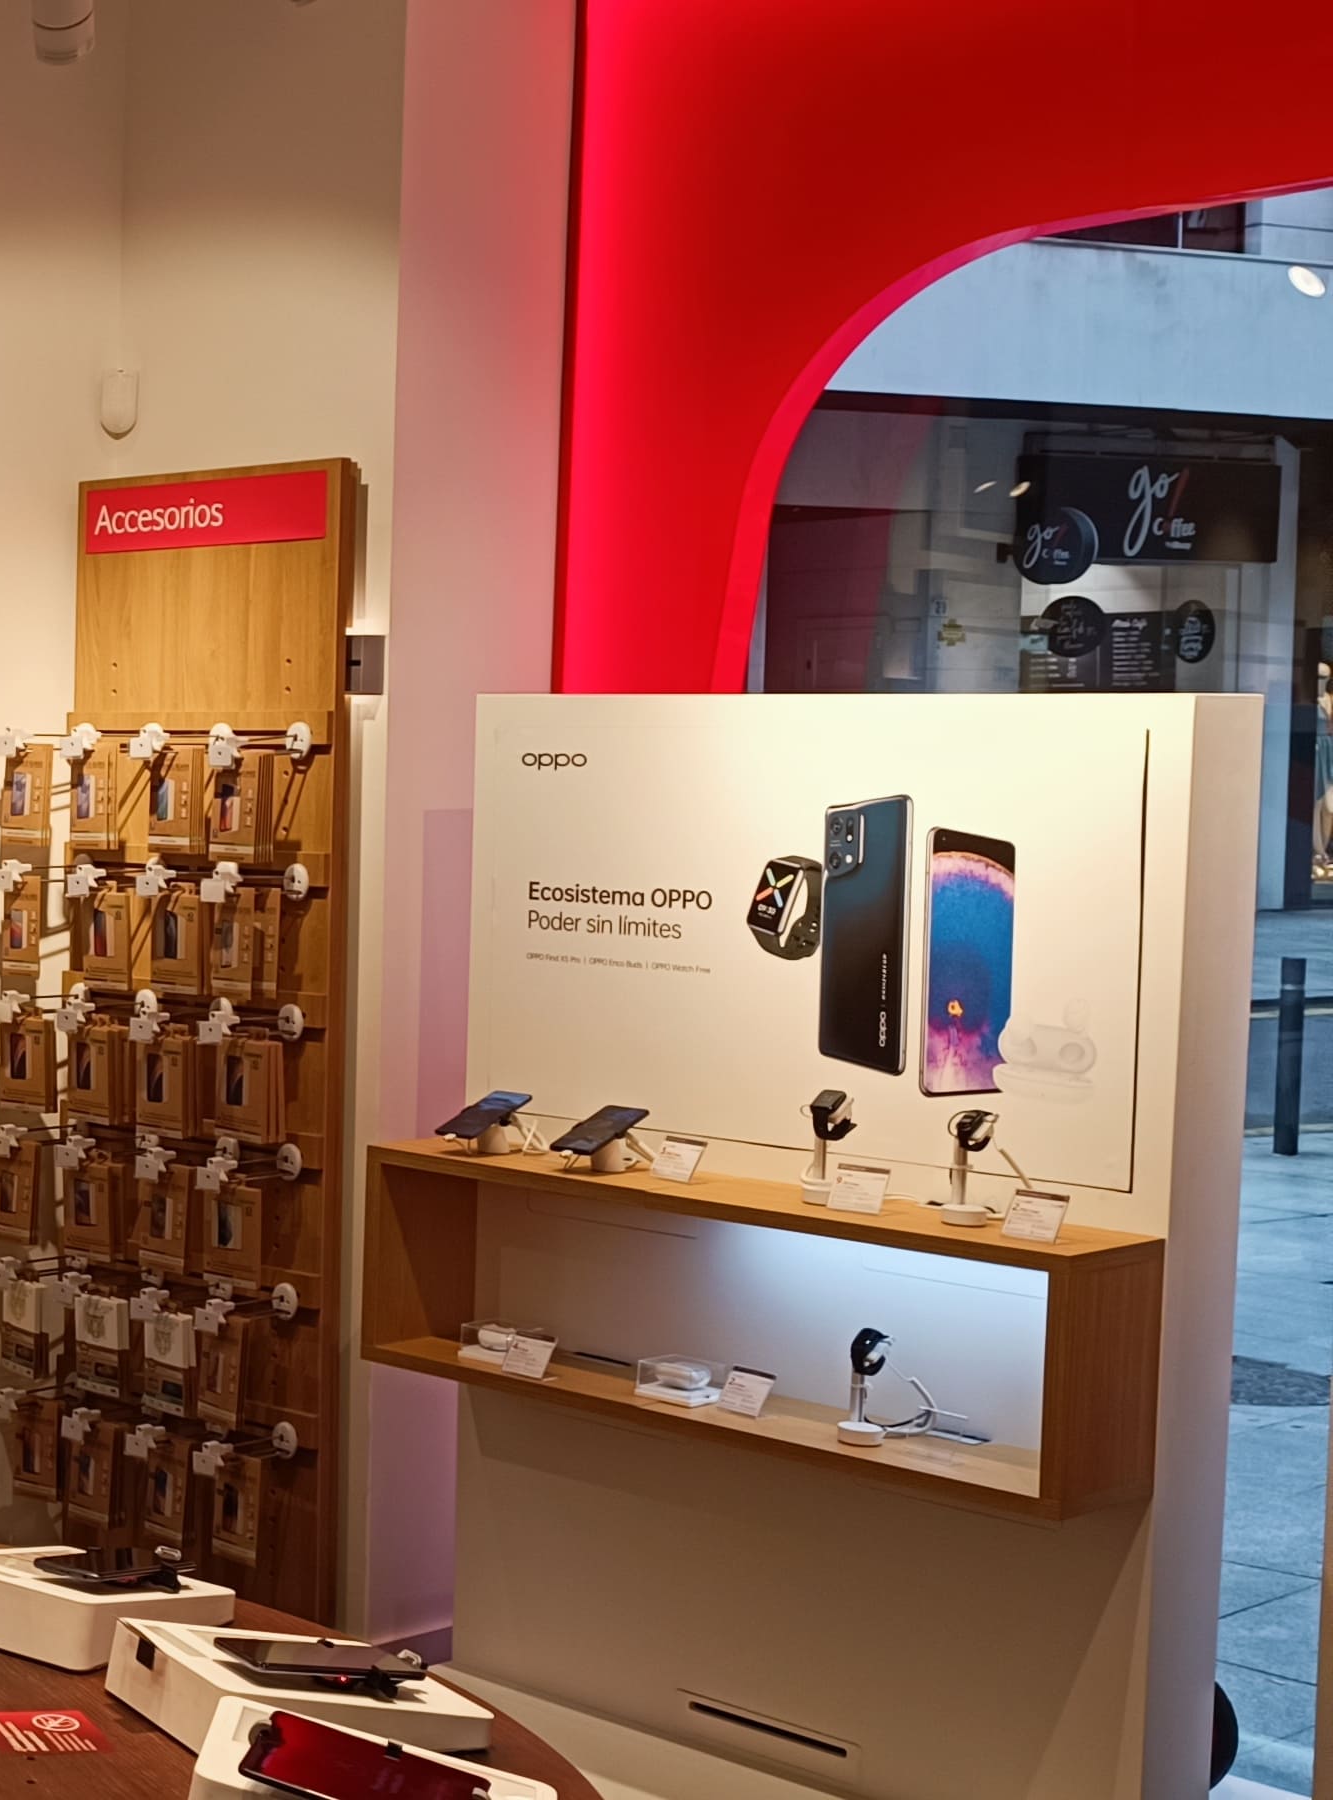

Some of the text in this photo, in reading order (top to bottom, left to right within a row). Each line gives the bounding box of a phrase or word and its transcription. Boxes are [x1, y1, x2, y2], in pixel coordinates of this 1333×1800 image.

[93, 497, 224, 535] Accesorios
[528, 881, 713, 911] Ecosistema OPPO
[527, 909, 683, 940] Poder sin límites
